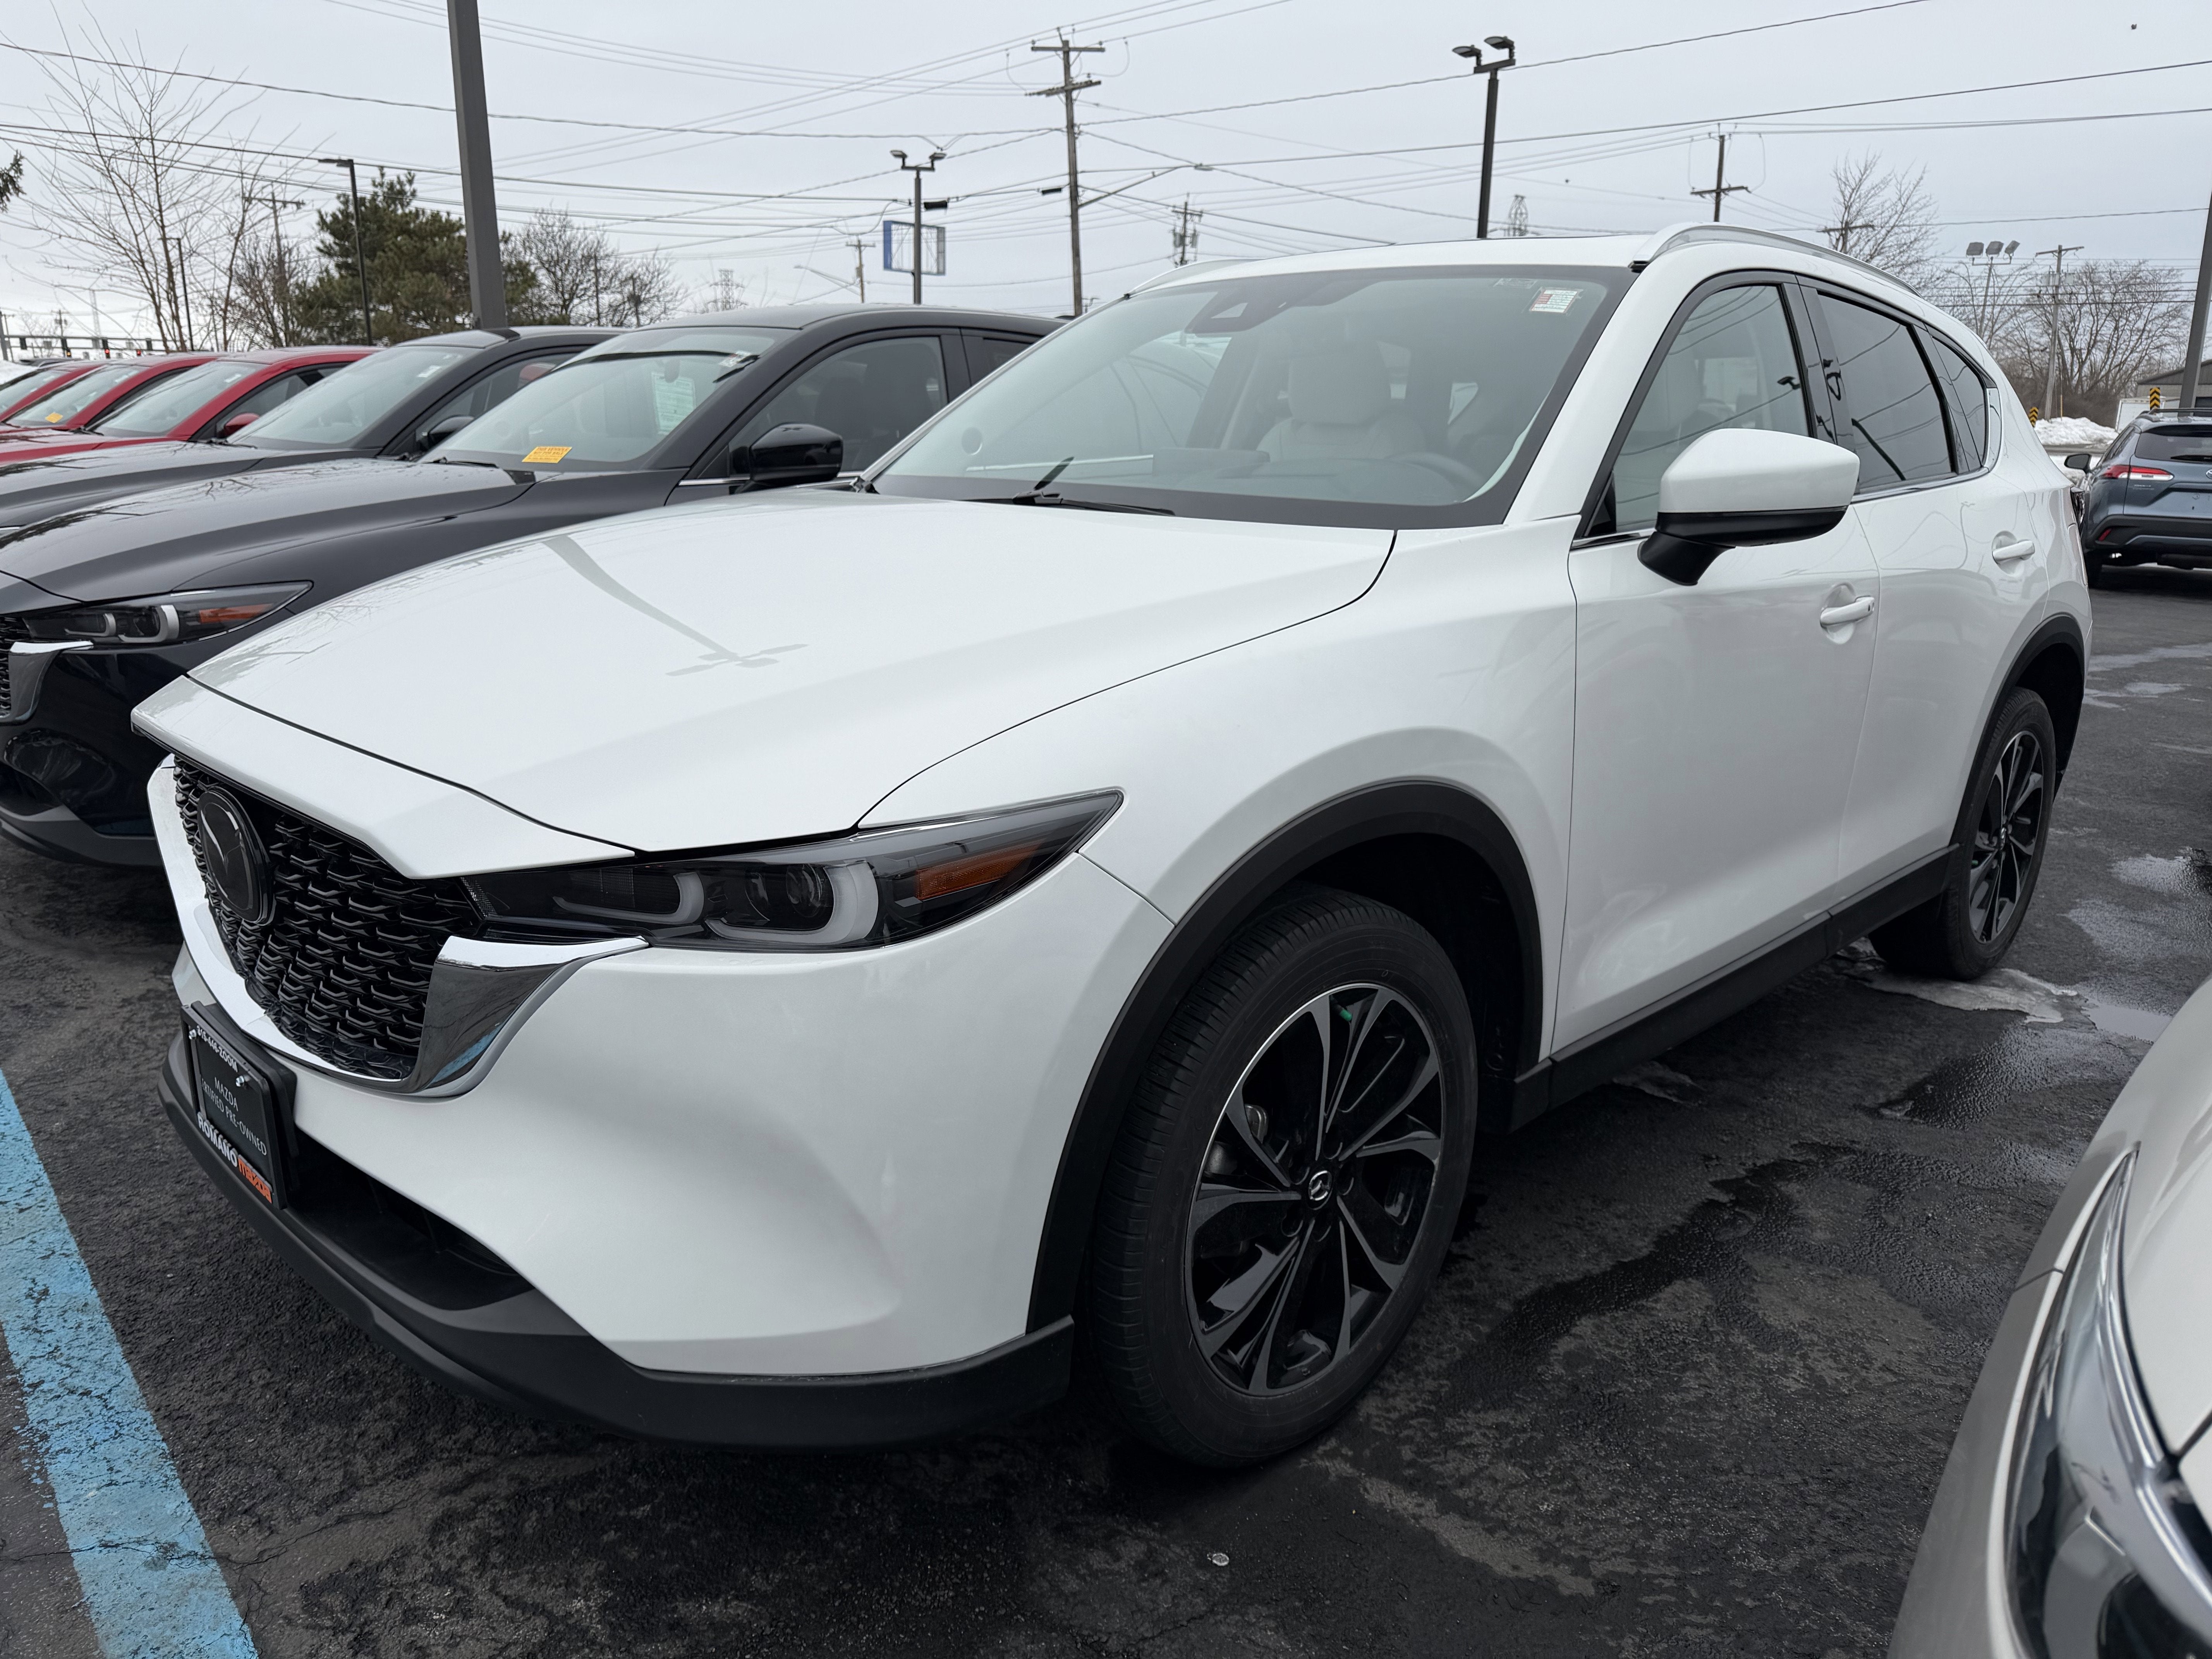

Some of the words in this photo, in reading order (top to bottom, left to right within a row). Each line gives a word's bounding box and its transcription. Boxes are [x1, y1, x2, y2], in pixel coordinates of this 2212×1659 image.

[202, 1078, 224, 1112] ERTIFIED
[225, 1106, 267, 1156] PRE-OWNED
[215, 1077, 238, 1111] MAZDA
[198, 1112, 238, 1167] ROMANO
